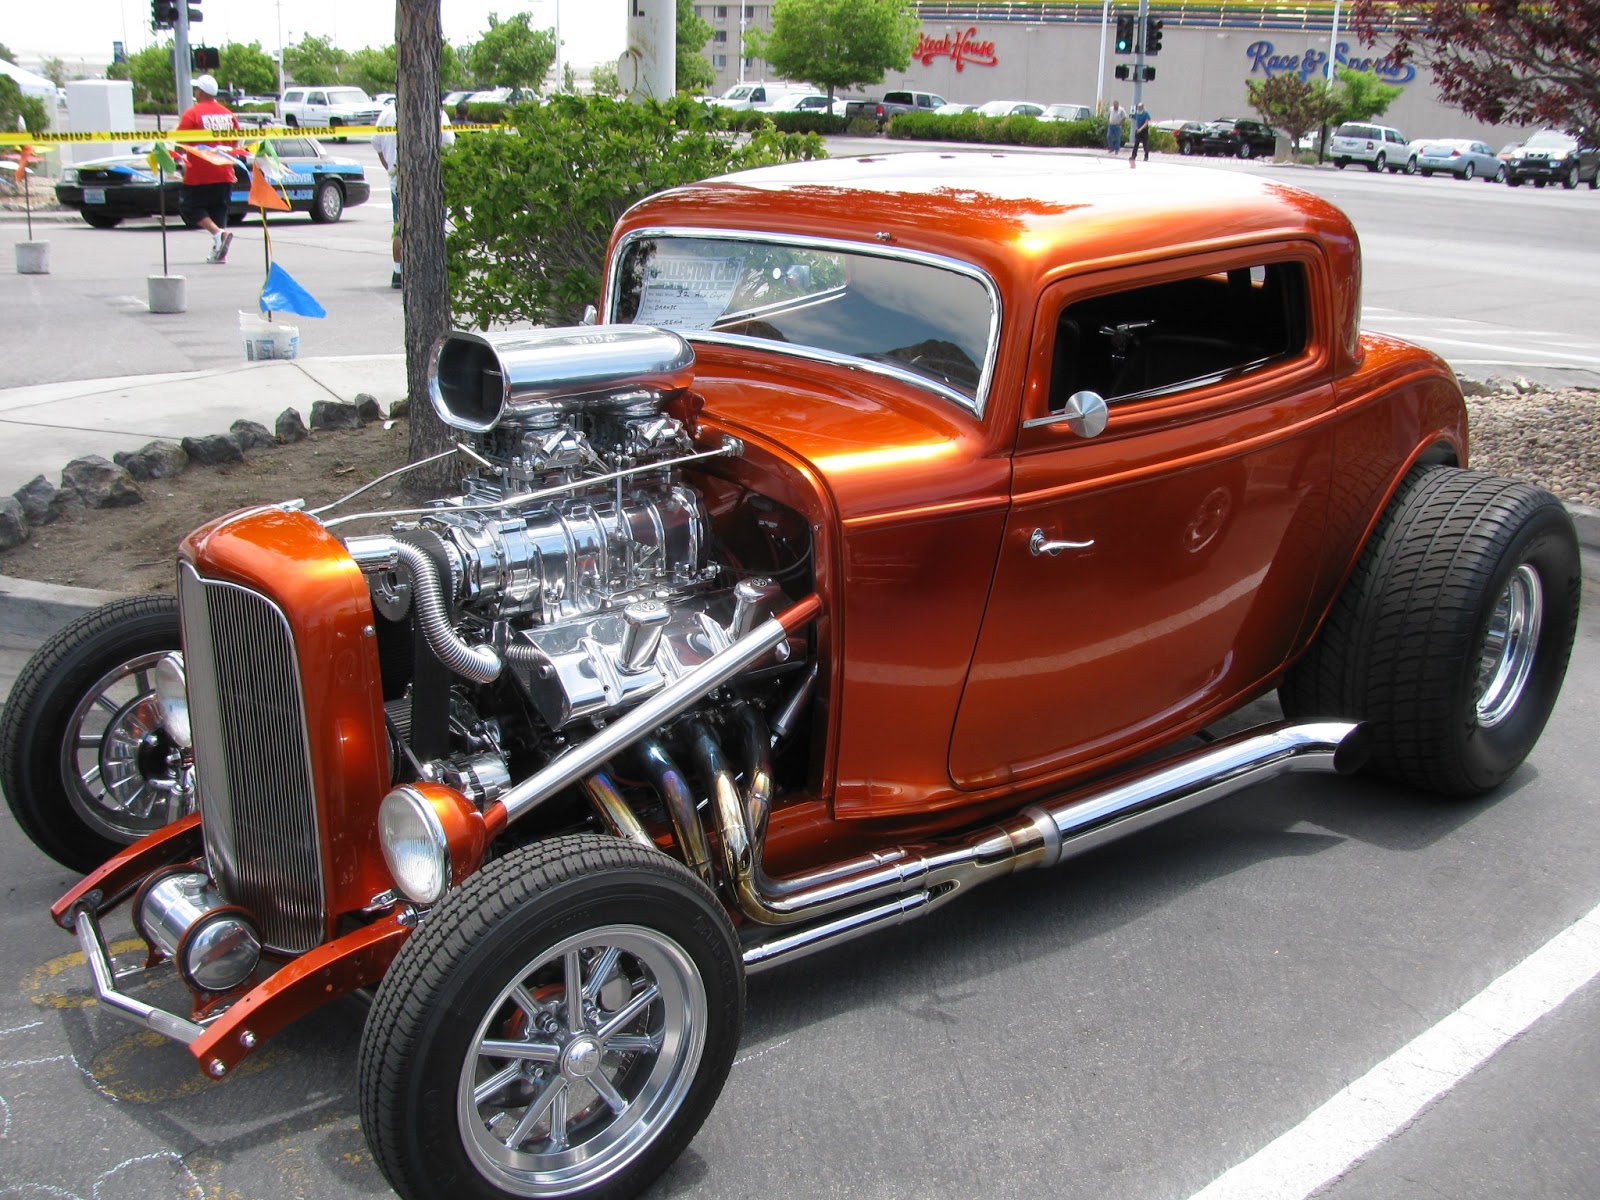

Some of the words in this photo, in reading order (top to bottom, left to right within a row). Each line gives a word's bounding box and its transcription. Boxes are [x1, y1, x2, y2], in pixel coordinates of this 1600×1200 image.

[944, 27, 998, 72] House
[1246, 40, 1300, 79] Race
[201, 114, 233, 123] EVENT
[278, 173, 312, 183] ENDOVER
[663, 281, 720, 290] PROFILE
[676, 290, 690, 298] 32
